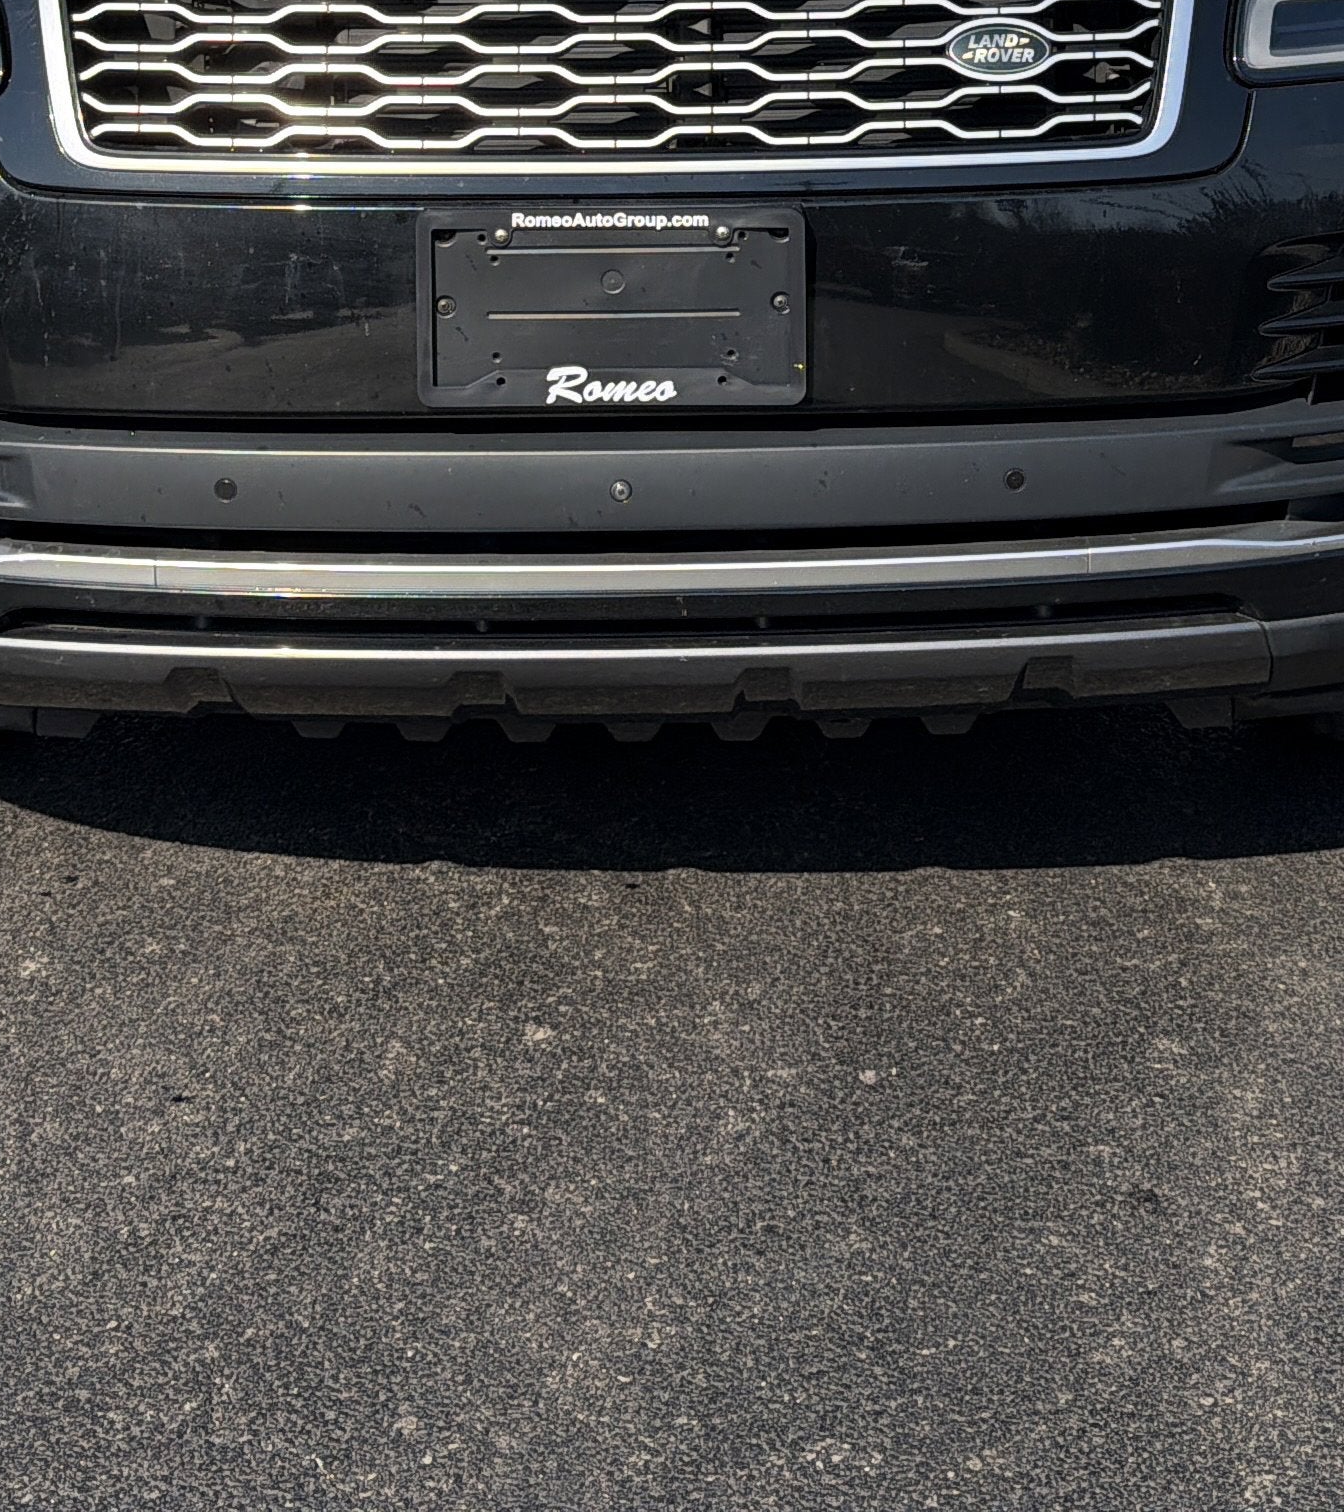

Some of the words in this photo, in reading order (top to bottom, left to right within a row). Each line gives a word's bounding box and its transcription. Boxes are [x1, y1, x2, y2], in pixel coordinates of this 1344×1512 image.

[967, 33, 1019, 49] LAND
[973, 47, 1036, 64] ROVER
[511, 211, 710, 230] RomeoAutoGroup.com
[544, 365, 678, 406] Romeo
